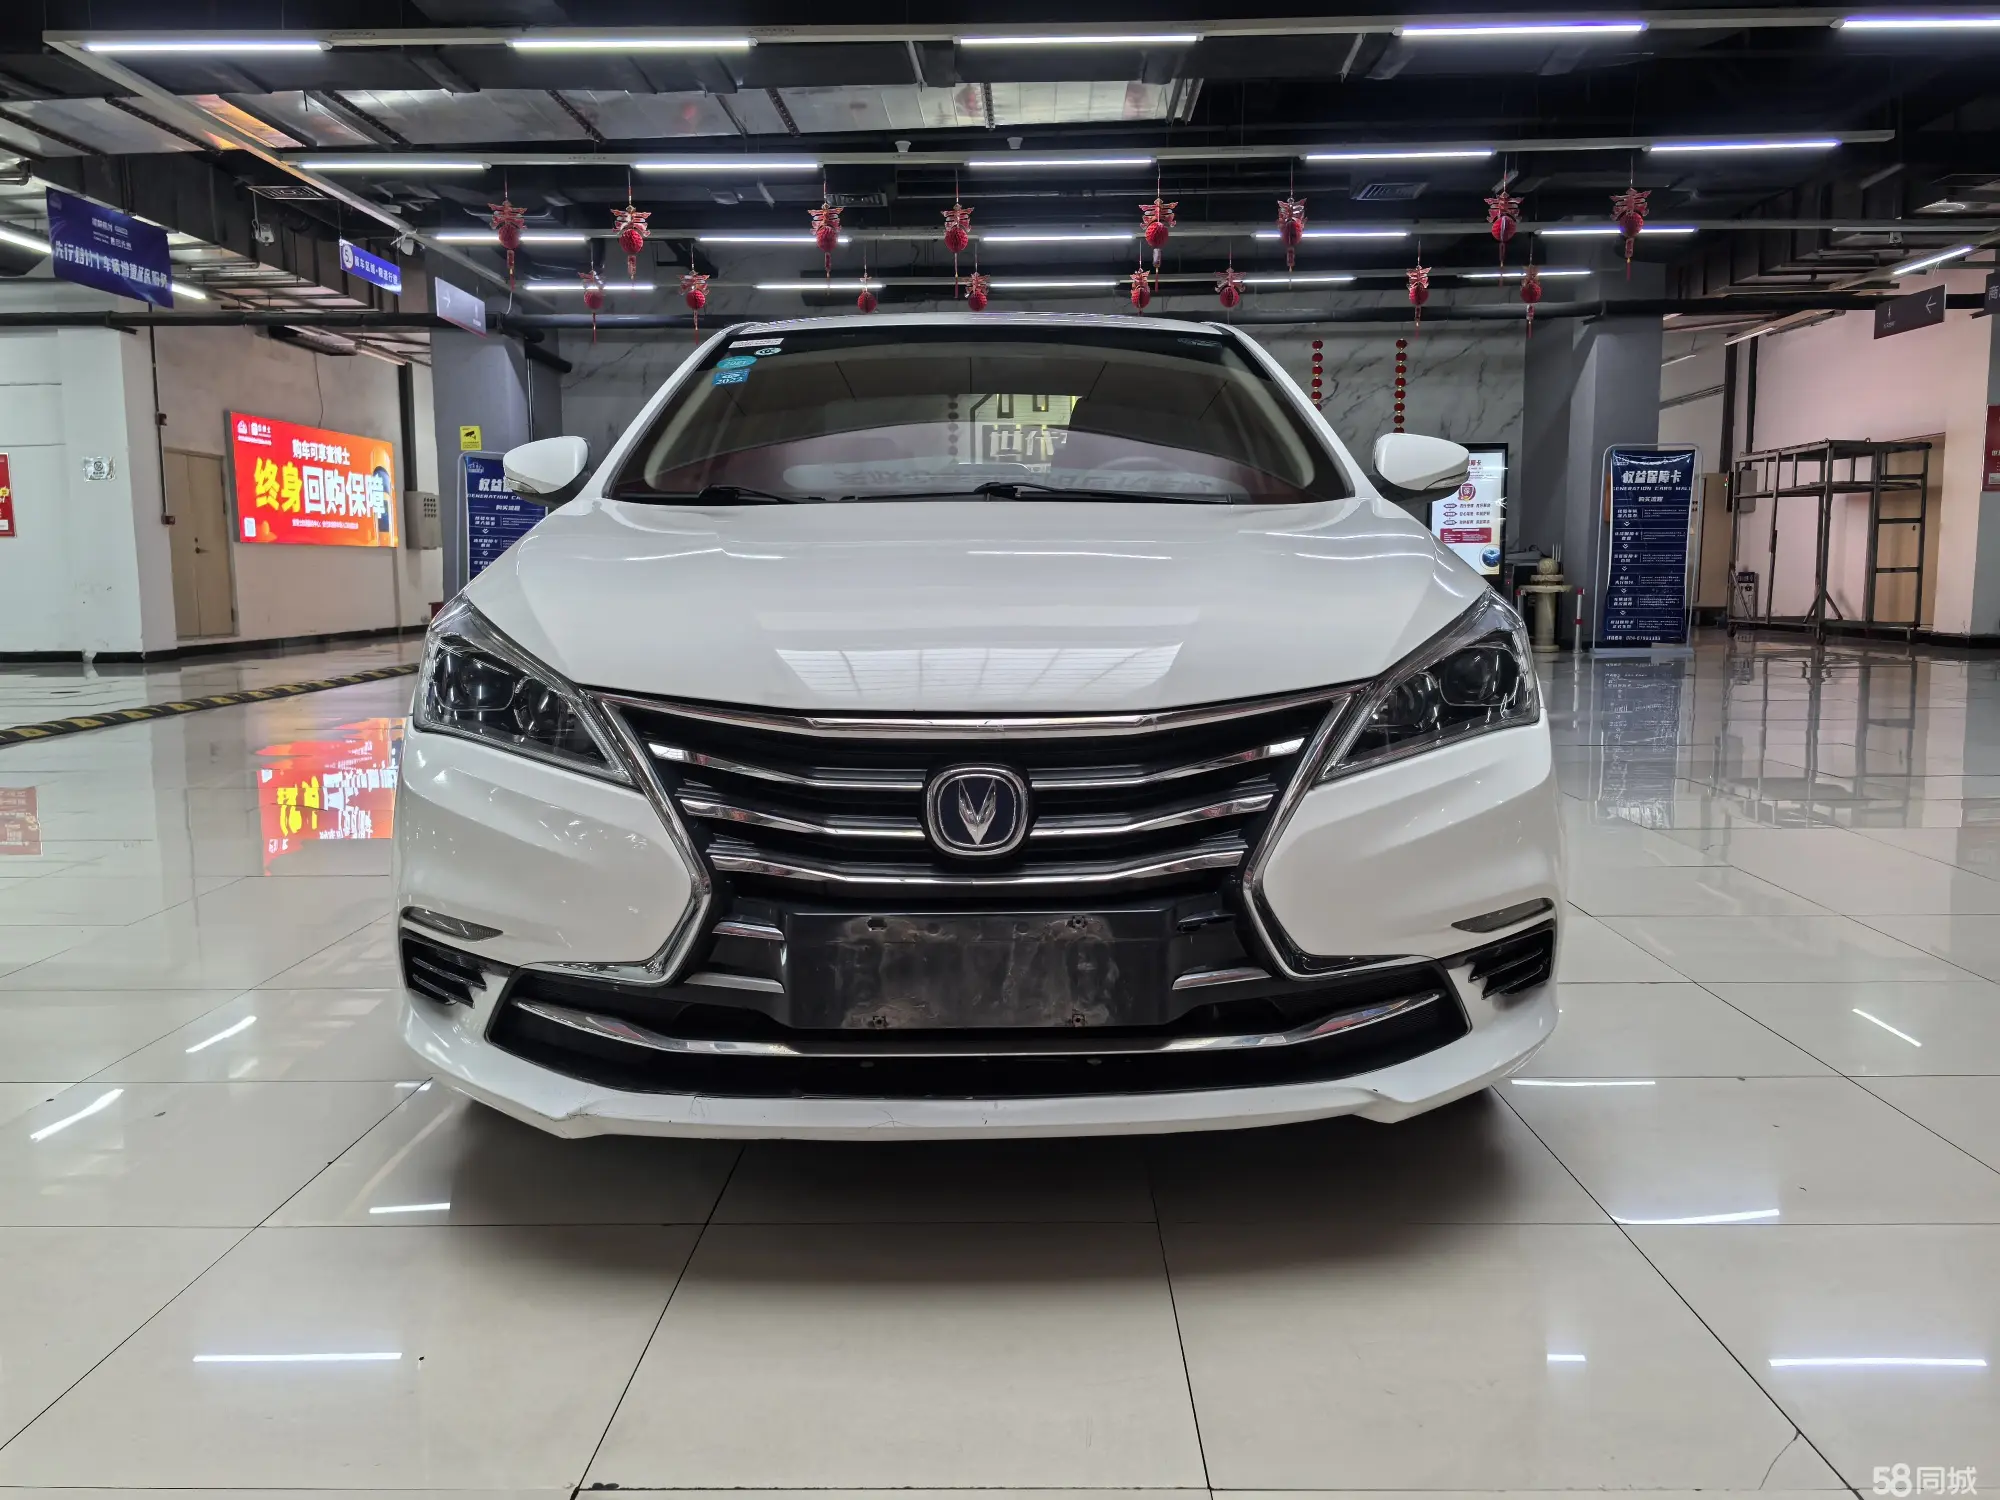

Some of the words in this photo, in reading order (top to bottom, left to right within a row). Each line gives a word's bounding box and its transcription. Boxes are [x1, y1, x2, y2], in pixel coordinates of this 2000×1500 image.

[715, 376, 743, 385] 2022
[989, 430, 1068, 462] 世代
[254, 456, 386, 519] 终身回购保障
[1622, 469, 1682, 484] 权益保障卡
